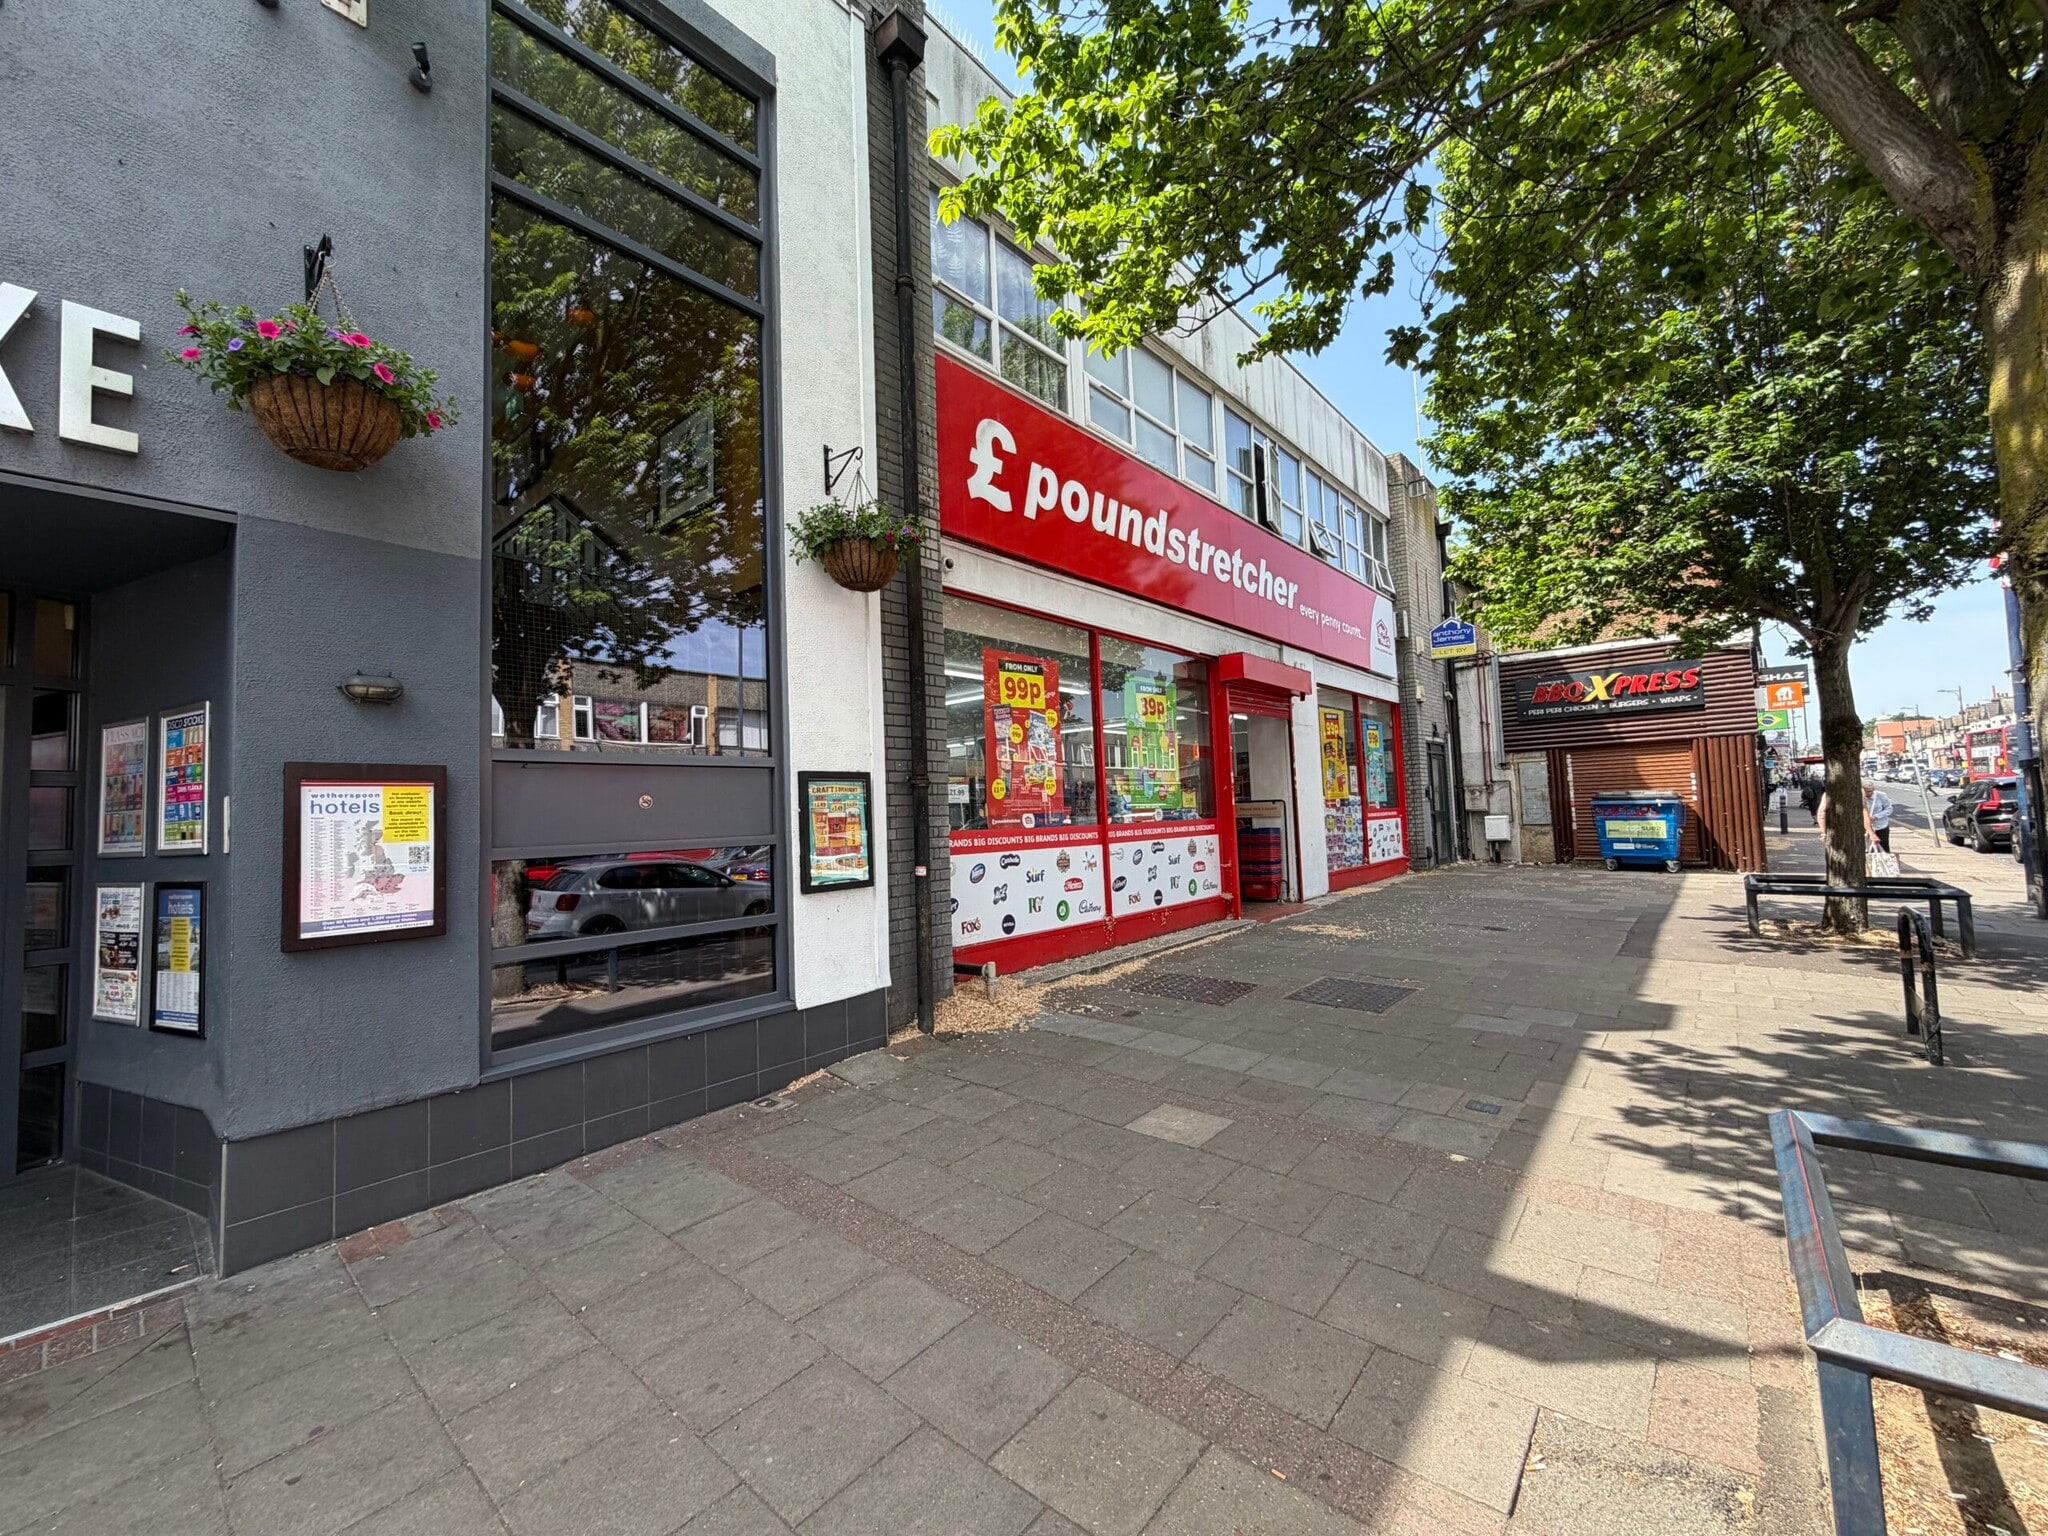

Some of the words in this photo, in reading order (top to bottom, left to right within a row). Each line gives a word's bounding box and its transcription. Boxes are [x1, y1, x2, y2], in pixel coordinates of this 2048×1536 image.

[1023, 461, 1299, 610] poundstretcher
[1299, 604, 1320, 625] every
[1321, 613, 1341, 633] penny
[1433, 628, 1471, 638] anthony
[1433, 634, 1465, 643] James
[1005, 663, 1022, 671] FROM
[1023, 665, 1038, 673] ONLY
[1758, 671, 1805, 682] SHAZ
[1004, 676, 1041, 705] 99p
[1141, 697, 1164, 720] 39p
[1528, 707, 1544, 716] PERI
[1546, 706, 1562, 715] PERI
[1564, 703, 1599, 712] CHICKEN
[1609, 700, 1649, 709] BURGERS
[1659, 695, 1692, 704] WRAPS
[812, 786, 834, 794] CRAFT
[310, 800, 380, 814] hotels
[974, 837, 986, 846] BIG
[987, 836, 1023, 845] DISCOUNTS
[1024, 834, 1034, 843] BIG
[1036, 834, 1058, 842] BRANDS
[1059, 832, 1069, 841] BIG
[1069, 831, 1099, 840] DISCOUNTS
[1116, 829, 1134, 838] BRANDS
[1143, 827, 1166, 835] DISCOUNTS
[1168, 855, 1181, 865] Surf
[1026, 869, 1045, 883] Surf
[168, 901, 194, 914] hotels
[1079, 900, 1101, 914] Cadbury
